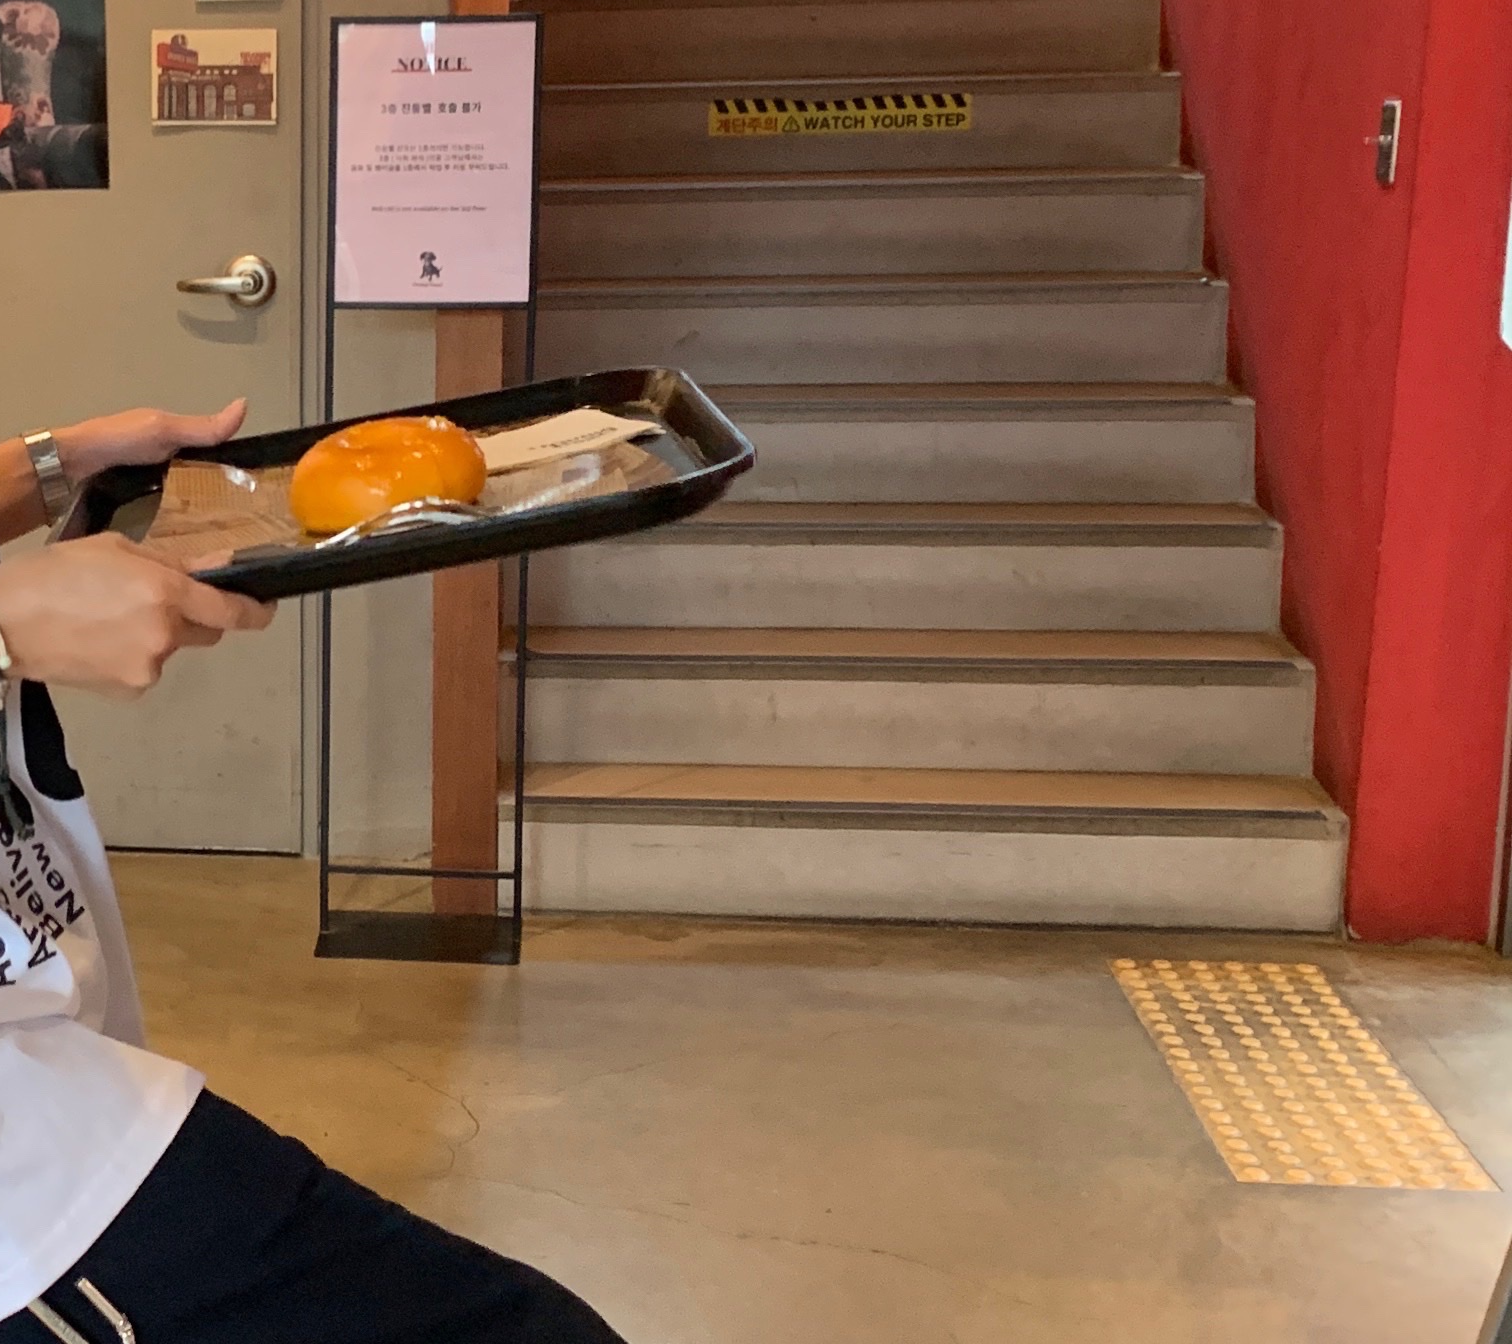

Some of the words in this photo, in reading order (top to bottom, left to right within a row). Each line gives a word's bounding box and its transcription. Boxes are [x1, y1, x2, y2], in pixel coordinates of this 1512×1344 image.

[398, 57, 467, 71] NOICE
[804, 115, 865, 131] WATCH
[871, 114, 918, 129] YOUR
[922, 112, 966, 128] STEP
[31, 842, 86, 926] New
